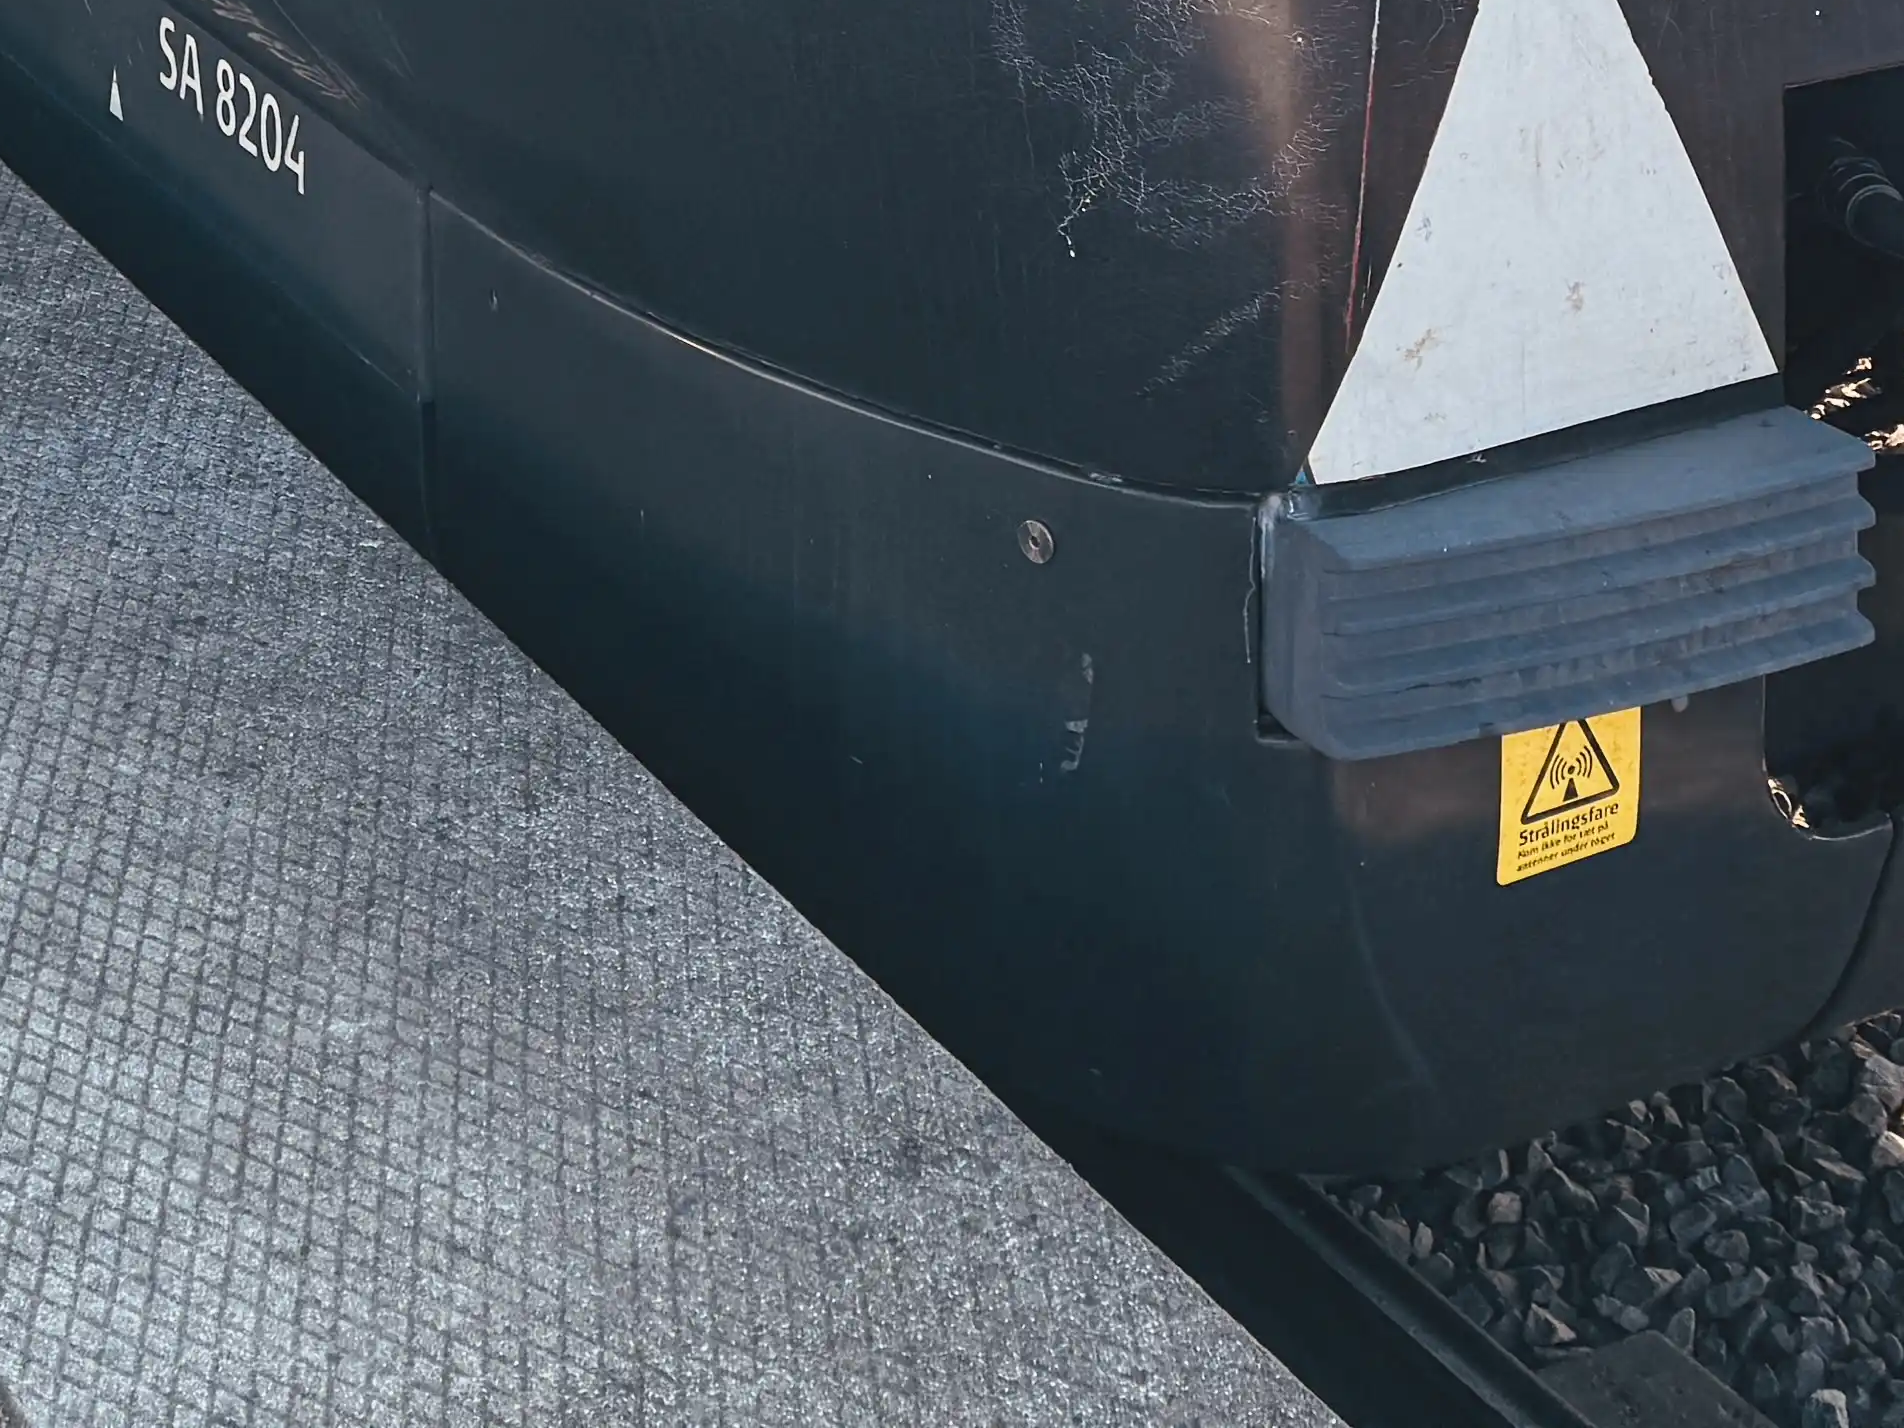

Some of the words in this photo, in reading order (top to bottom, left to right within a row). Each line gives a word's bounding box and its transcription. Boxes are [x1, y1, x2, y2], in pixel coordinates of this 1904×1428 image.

[159, 16, 205, 117] SA
[215, 58, 305, 195] 8204
[1519, 802, 1619, 847] Strålingsfare
